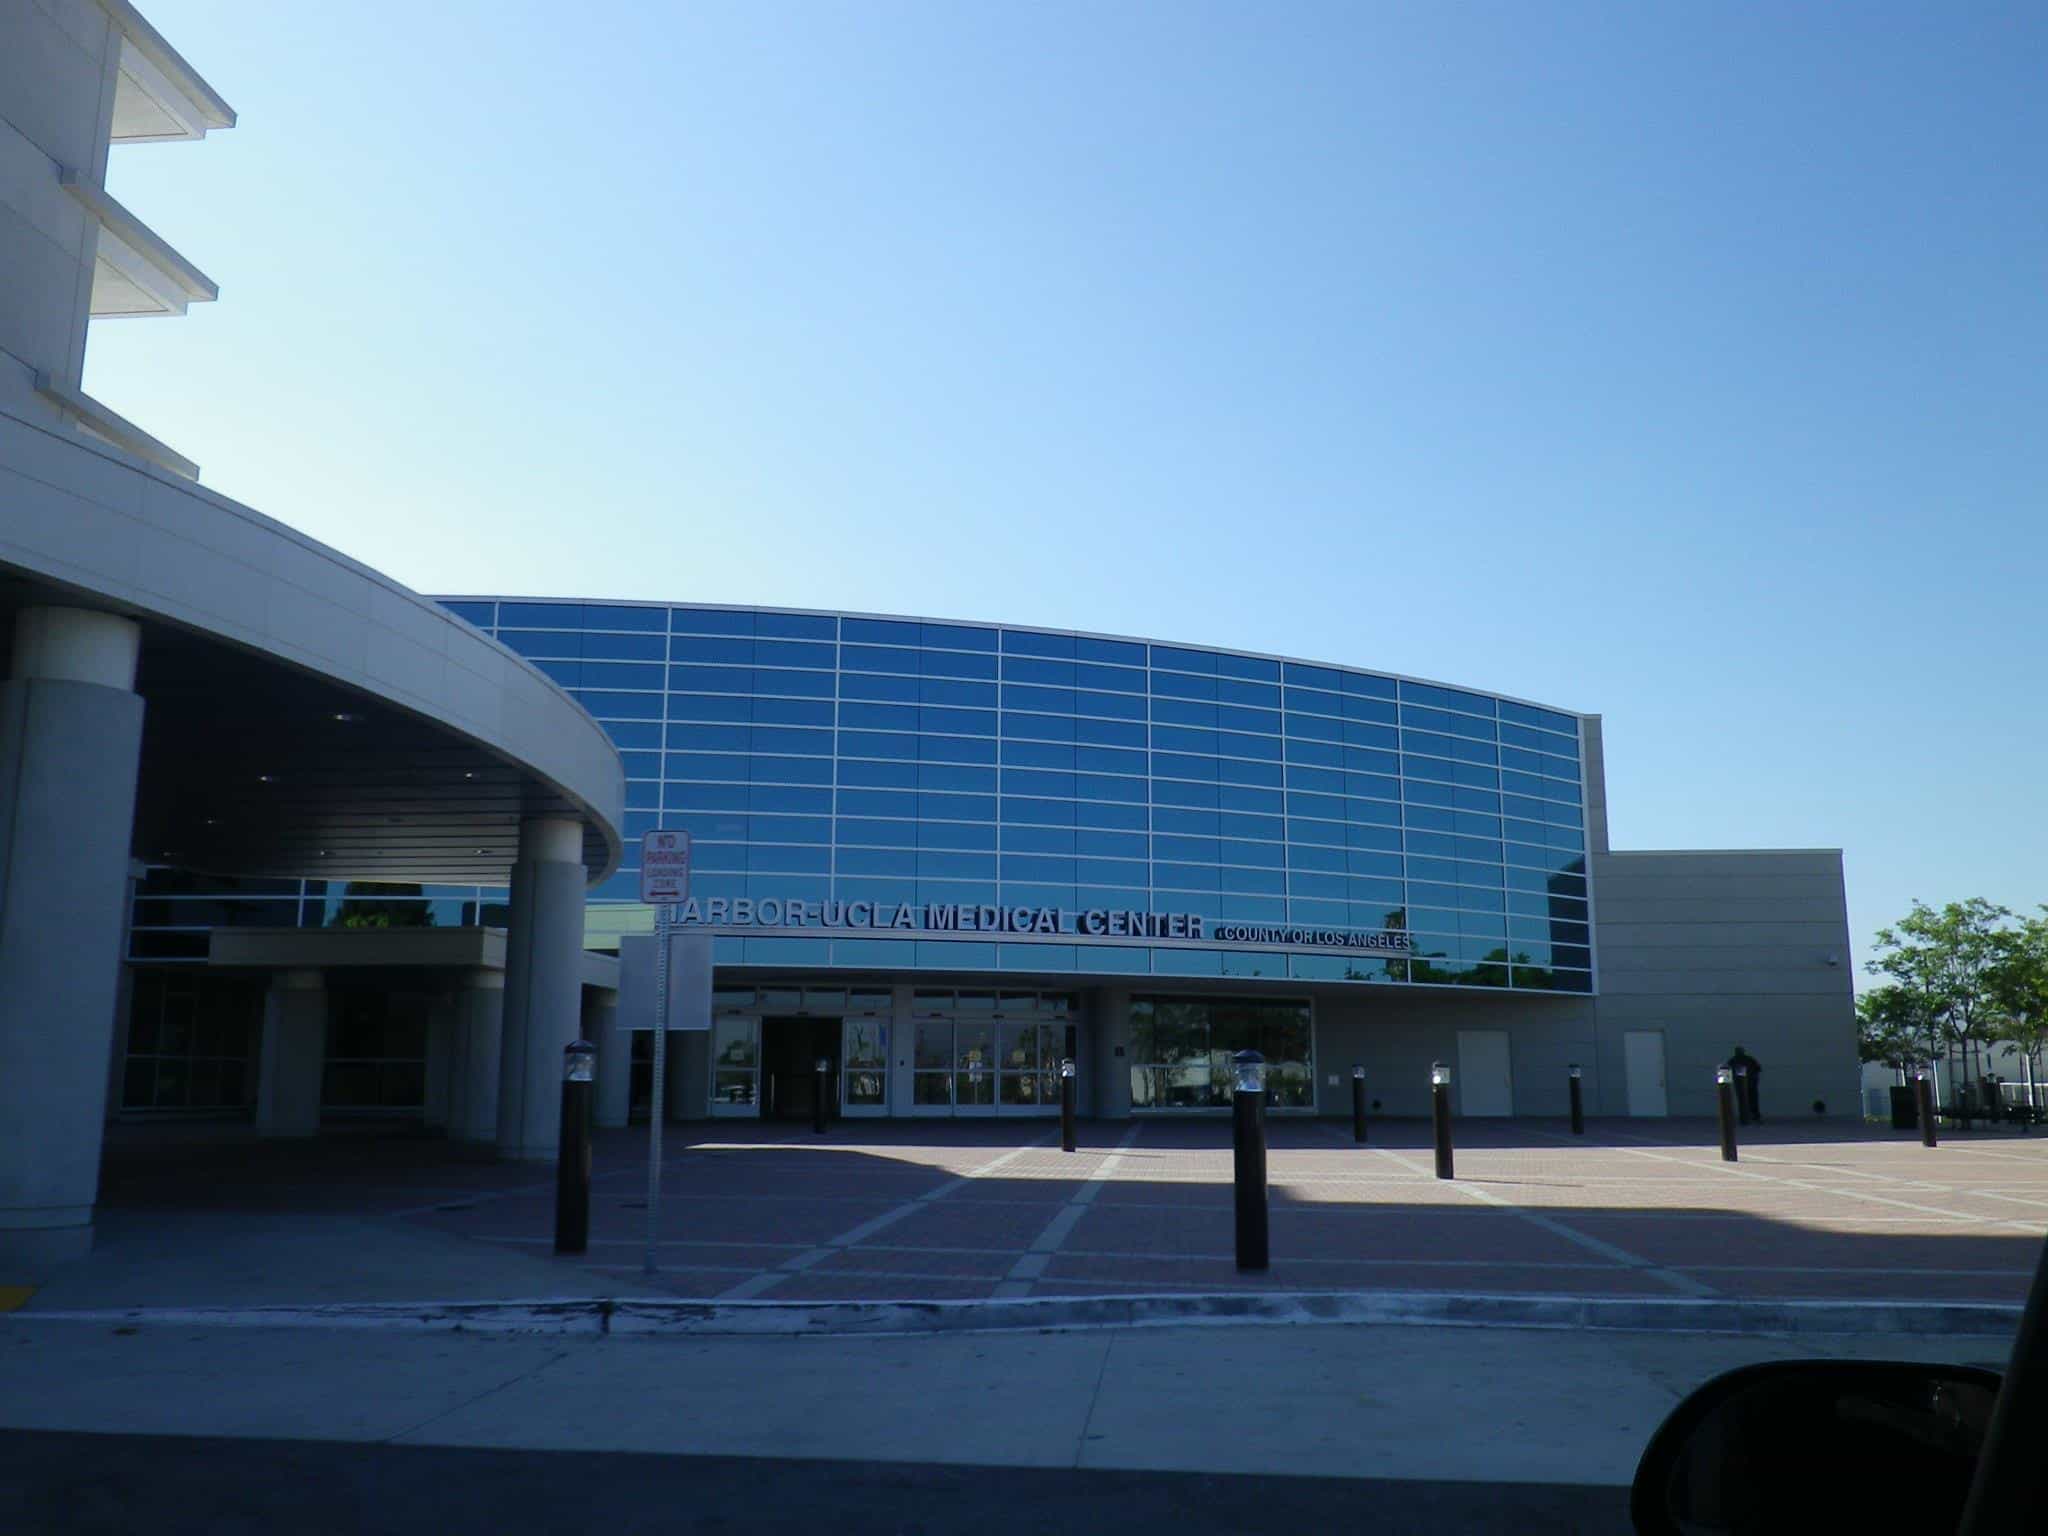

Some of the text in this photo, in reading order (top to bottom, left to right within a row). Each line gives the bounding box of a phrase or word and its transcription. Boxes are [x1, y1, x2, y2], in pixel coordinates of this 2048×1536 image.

[657, 834, 676, 849] NO
[647, 850, 686, 864] PARKING
[927, 903, 1073, 934] MEDICAL
[1085, 908, 1204, 939] CENTER
[1224, 927, 1288, 942] COUNTY
[1316, 930, 1344, 946] LOS
[1349, 933, 1410, 950] ANGELES
